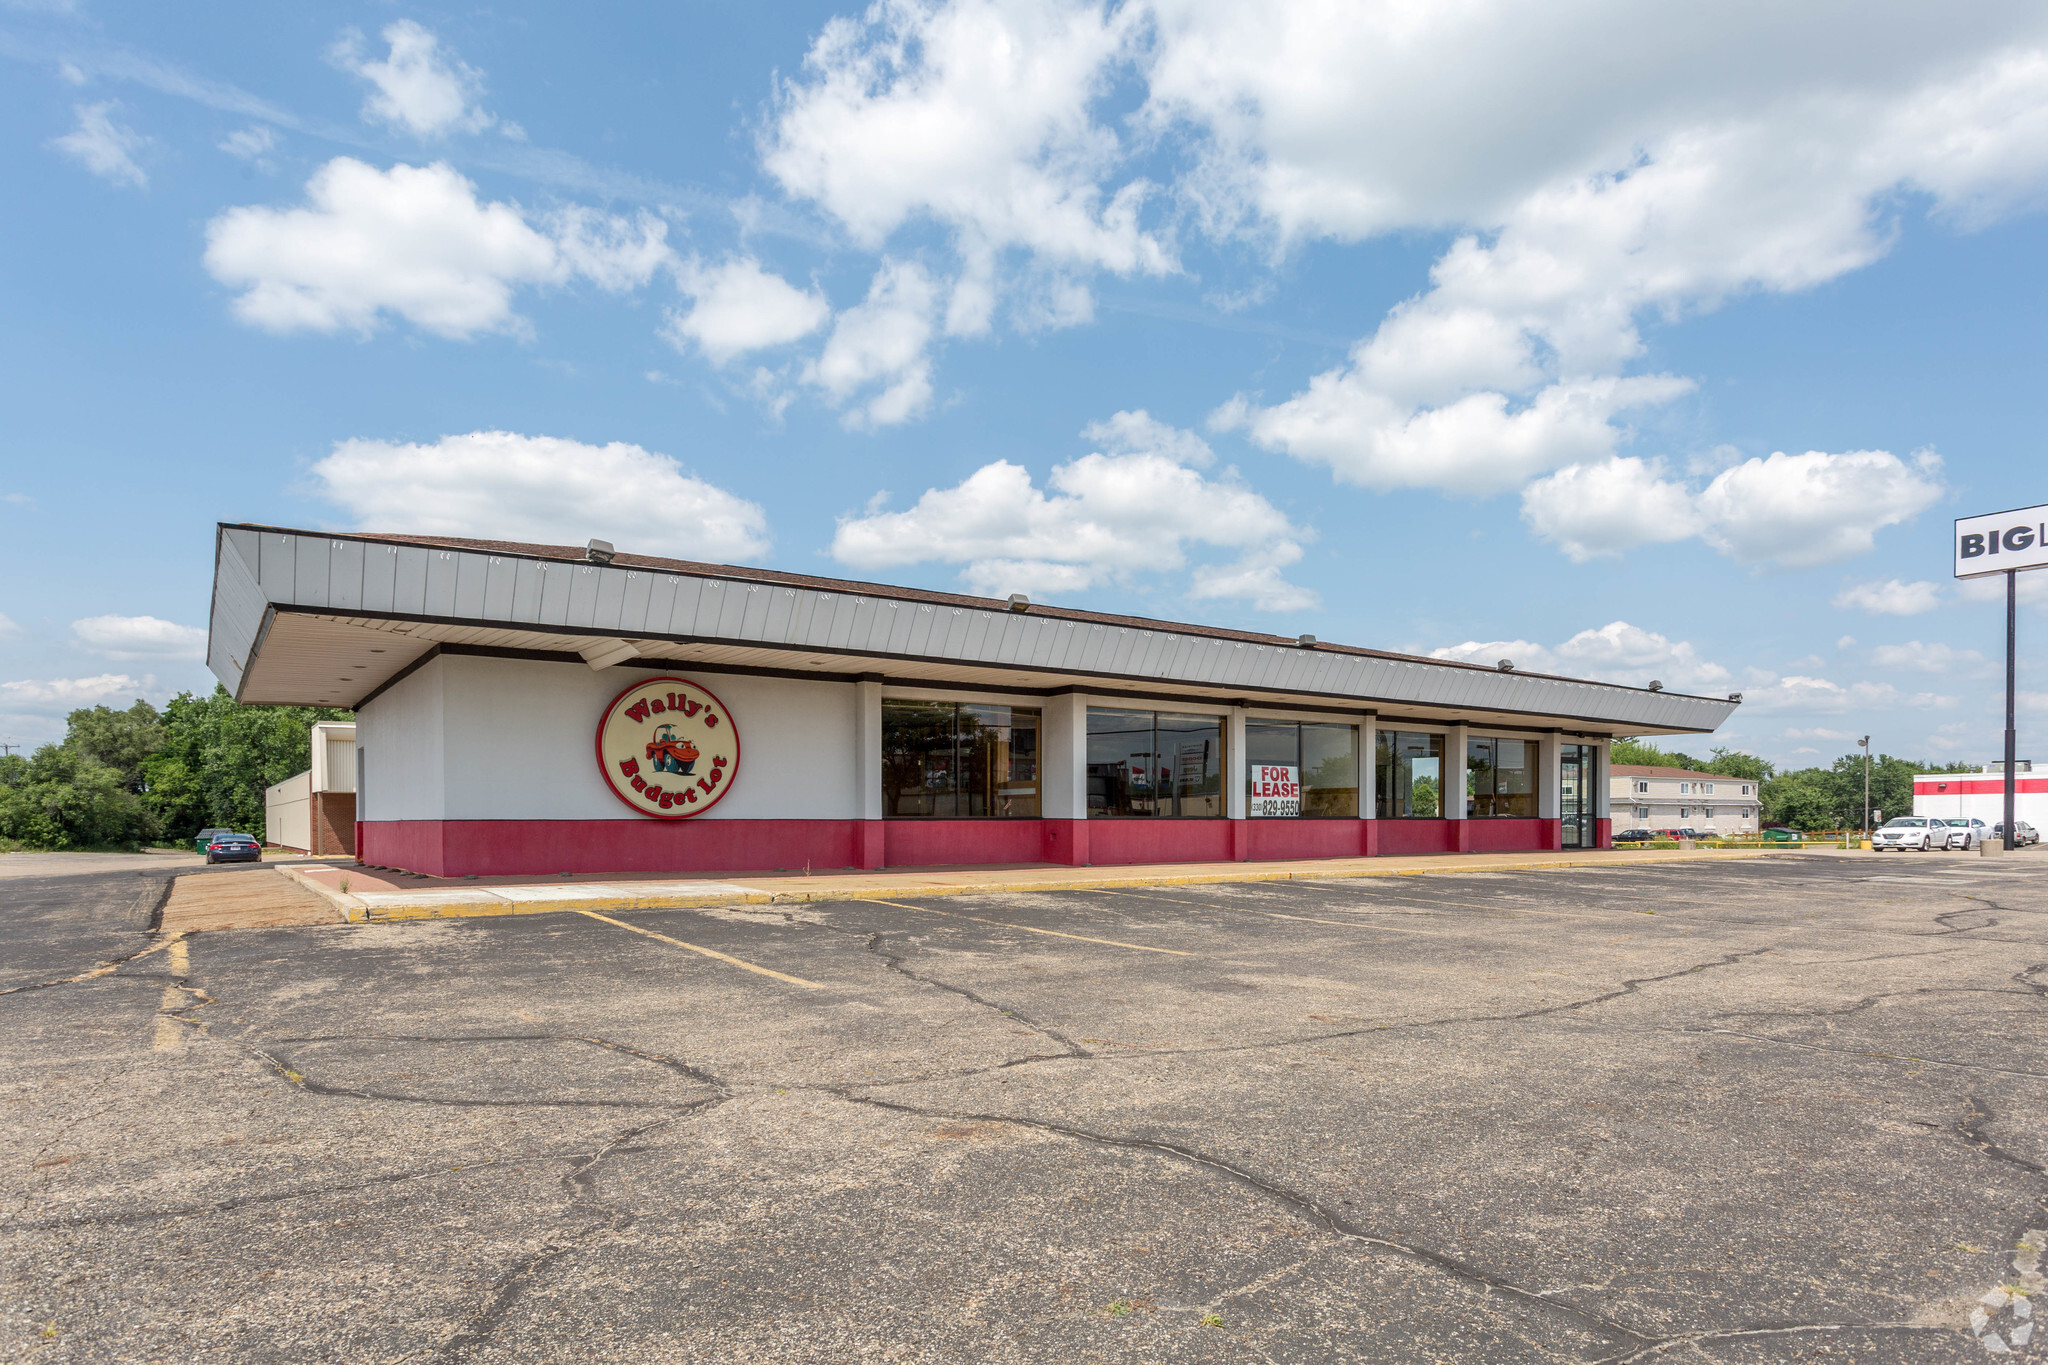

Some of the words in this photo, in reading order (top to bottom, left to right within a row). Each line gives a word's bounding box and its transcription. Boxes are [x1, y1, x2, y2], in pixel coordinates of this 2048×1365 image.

[1961, 526, 2035, 559] BIG
[624, 692, 719, 728] Wally's
[619, 757, 697, 809] Budget
[697, 755, 727, 795] Lot
[1261, 766, 1290, 782] FOR
[1252, 781, 1299, 798] LEASE
[1262, 799, 1299, 816] 829-9550
